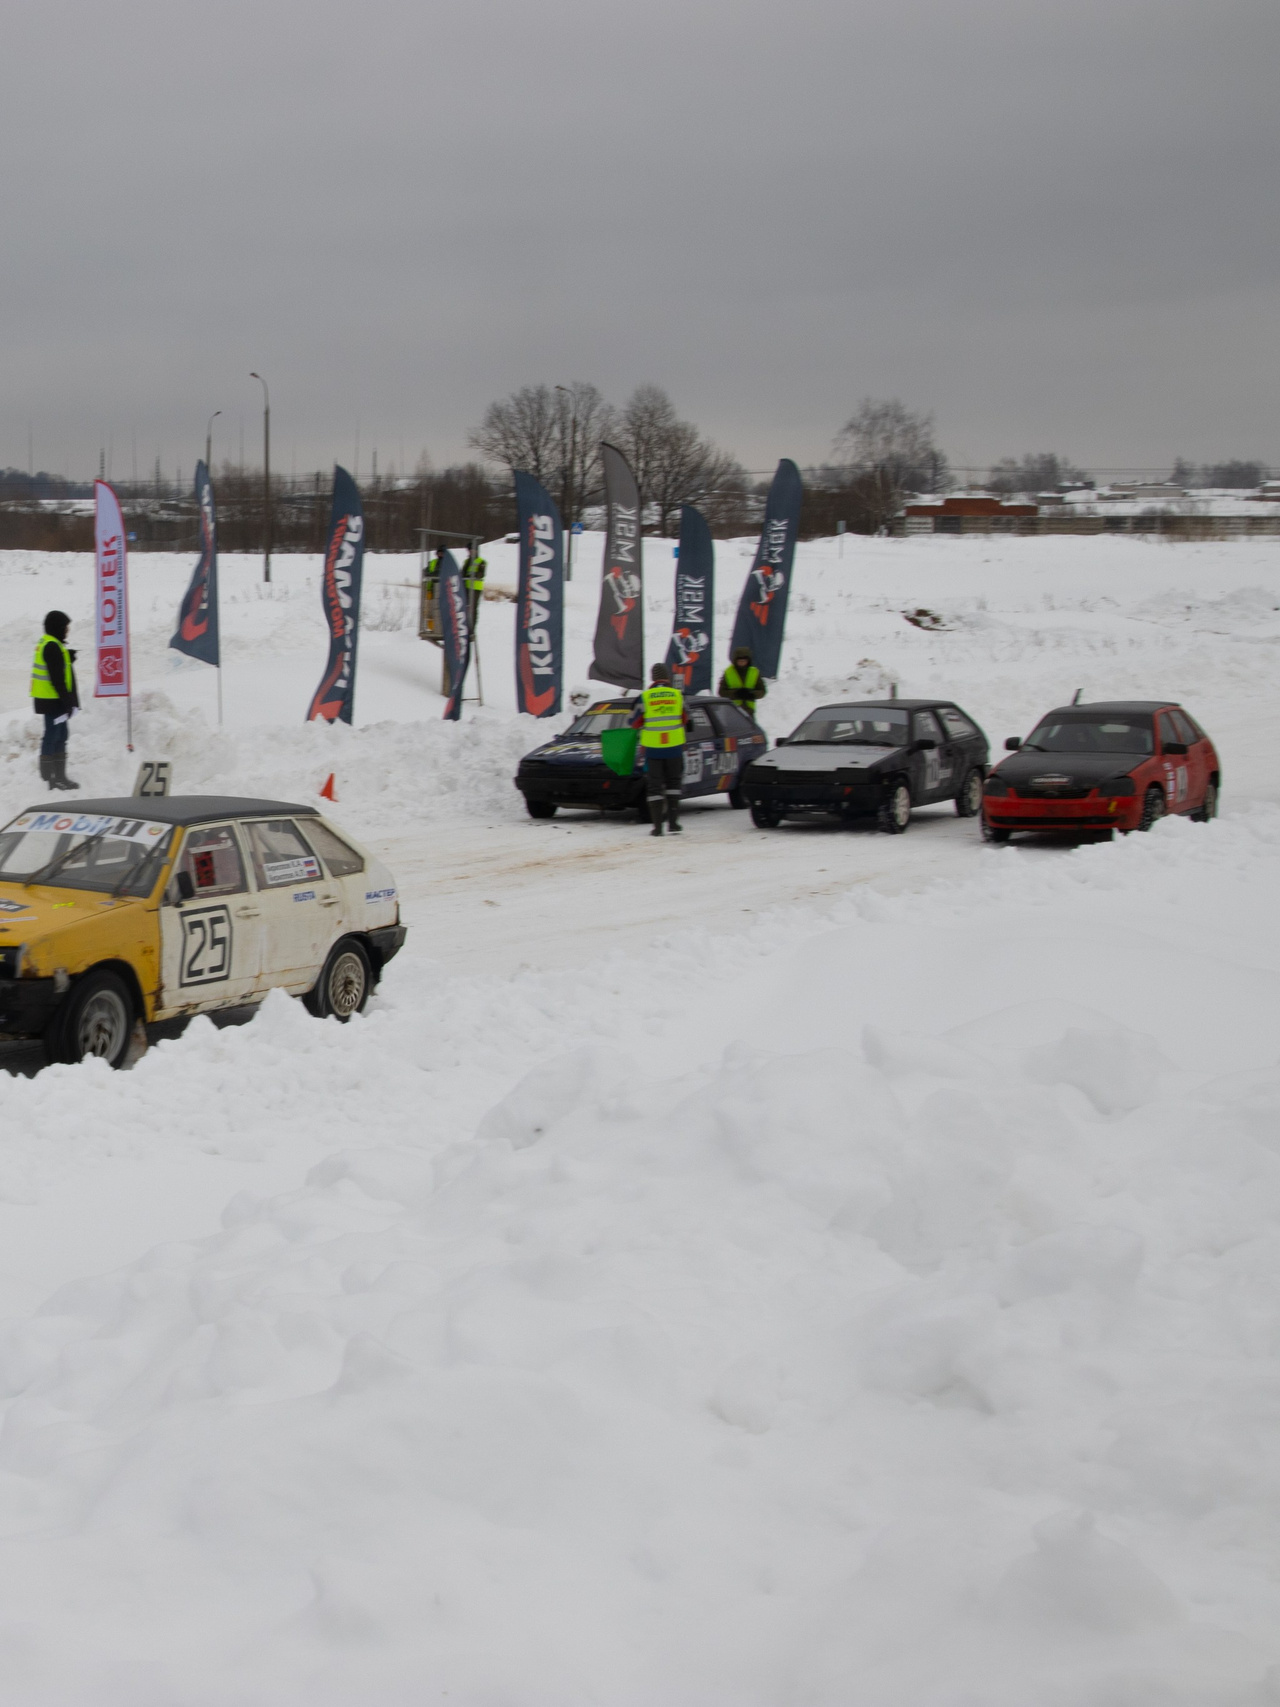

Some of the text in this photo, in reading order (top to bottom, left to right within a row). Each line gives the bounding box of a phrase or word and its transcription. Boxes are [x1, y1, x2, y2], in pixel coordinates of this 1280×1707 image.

[100, 535, 118, 643] TOTEK
[140, 763, 168, 796] 25
[29, 814, 139, 836] Mobil 1
[187, 916, 226, 978] 25
